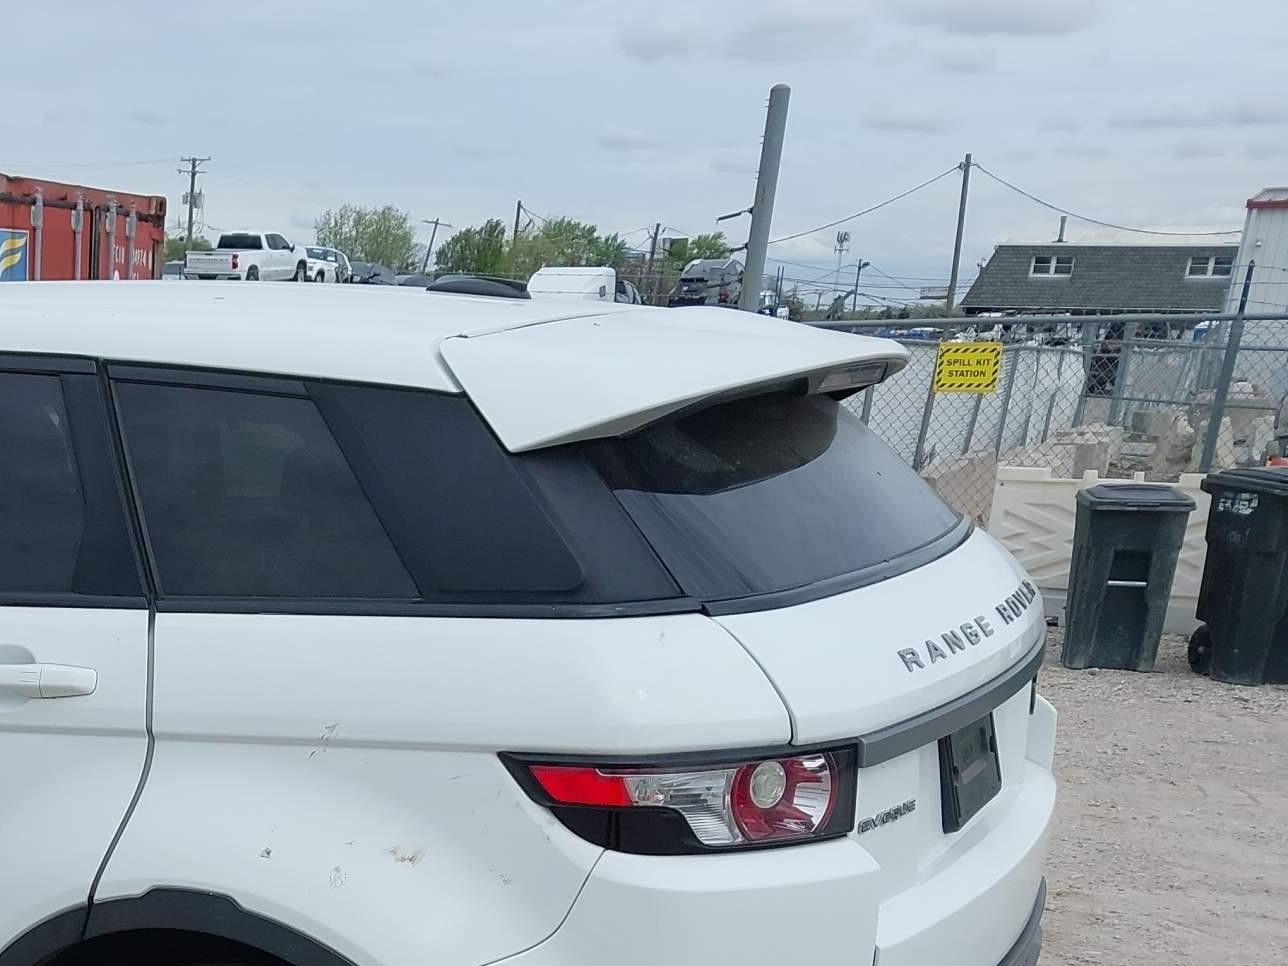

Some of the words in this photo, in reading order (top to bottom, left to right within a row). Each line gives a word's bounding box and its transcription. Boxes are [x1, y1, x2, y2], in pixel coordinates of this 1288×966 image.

[946, 358, 972, 367] SPILL
[976, 358, 992, 367] KIT
[948, 369, 987, 378] STATION
[896, 615, 995, 673] RANGE
[995, 578, 1037, 626] ROVER
[857, 799, 917, 835] EVOQUE
